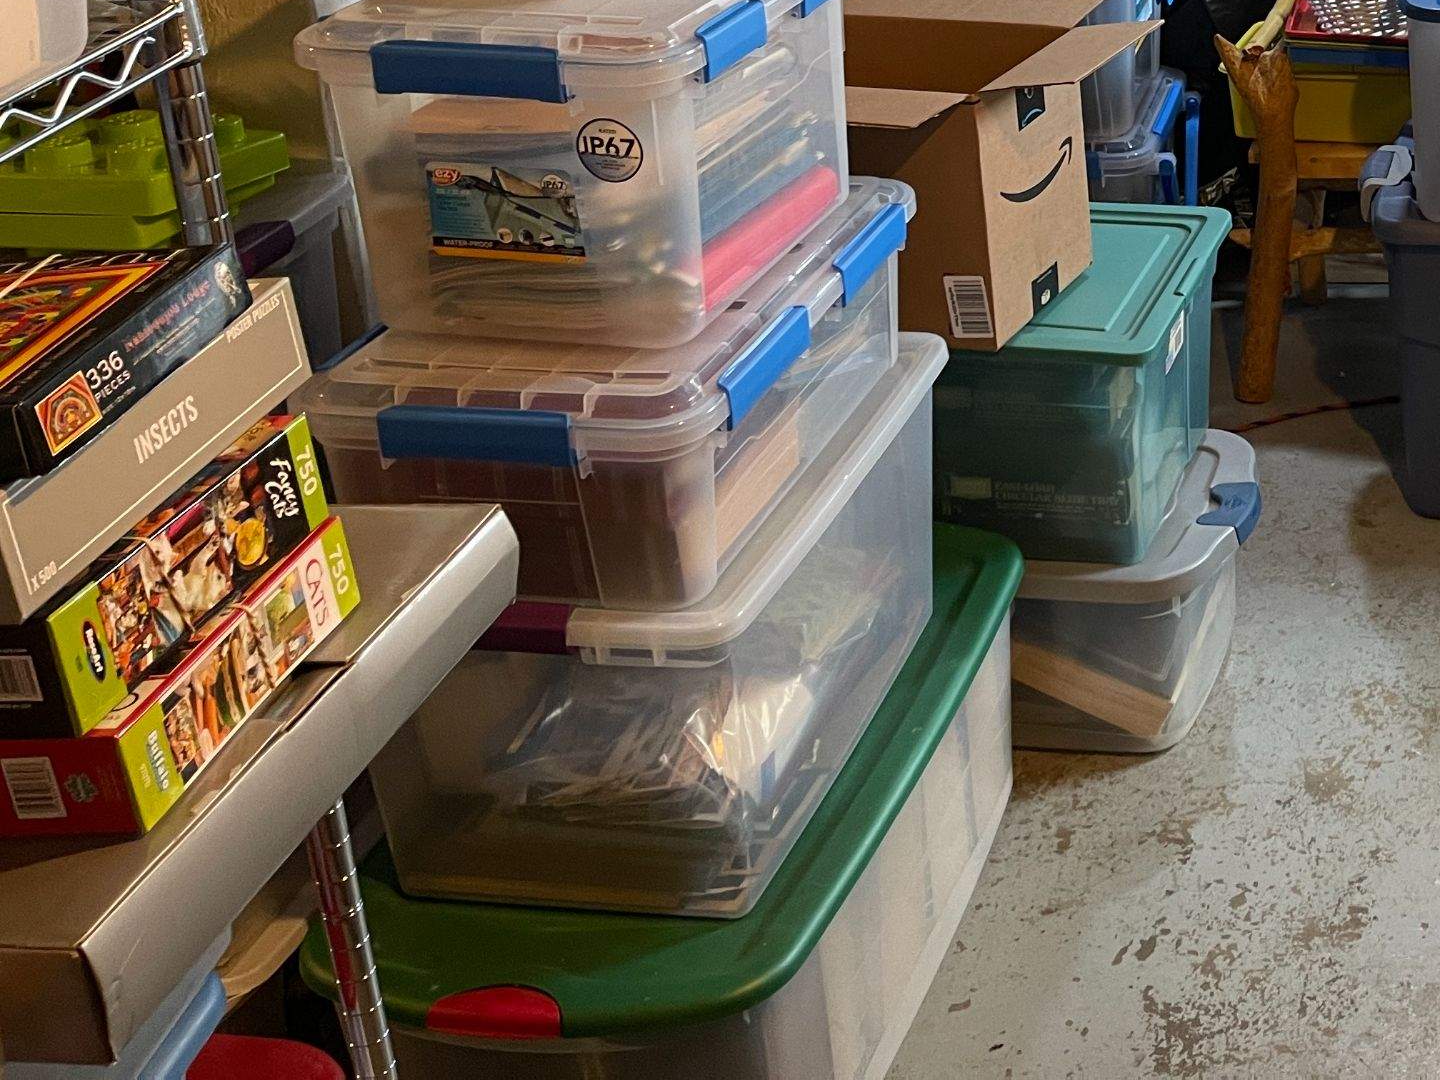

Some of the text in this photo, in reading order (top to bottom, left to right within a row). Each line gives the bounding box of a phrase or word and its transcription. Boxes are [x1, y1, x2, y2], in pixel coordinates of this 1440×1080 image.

[582, 135, 635, 159] IP67
[434, 168, 459, 181] ezy
[443, 239, 494, 248] WATER-PROOF
[225, 294, 281, 344] POSTER PUZZLES
[86, 350, 124, 391] 336
[94, 370, 131, 405] PIECES
[132, 394, 200, 465] INSECTS
[269, 457, 300, 517] Fancy
[296, 444, 318, 496] 750
[39, 561, 58, 586] 500
[303, 558, 330, 627] CATS
[327, 545, 349, 596] 750
